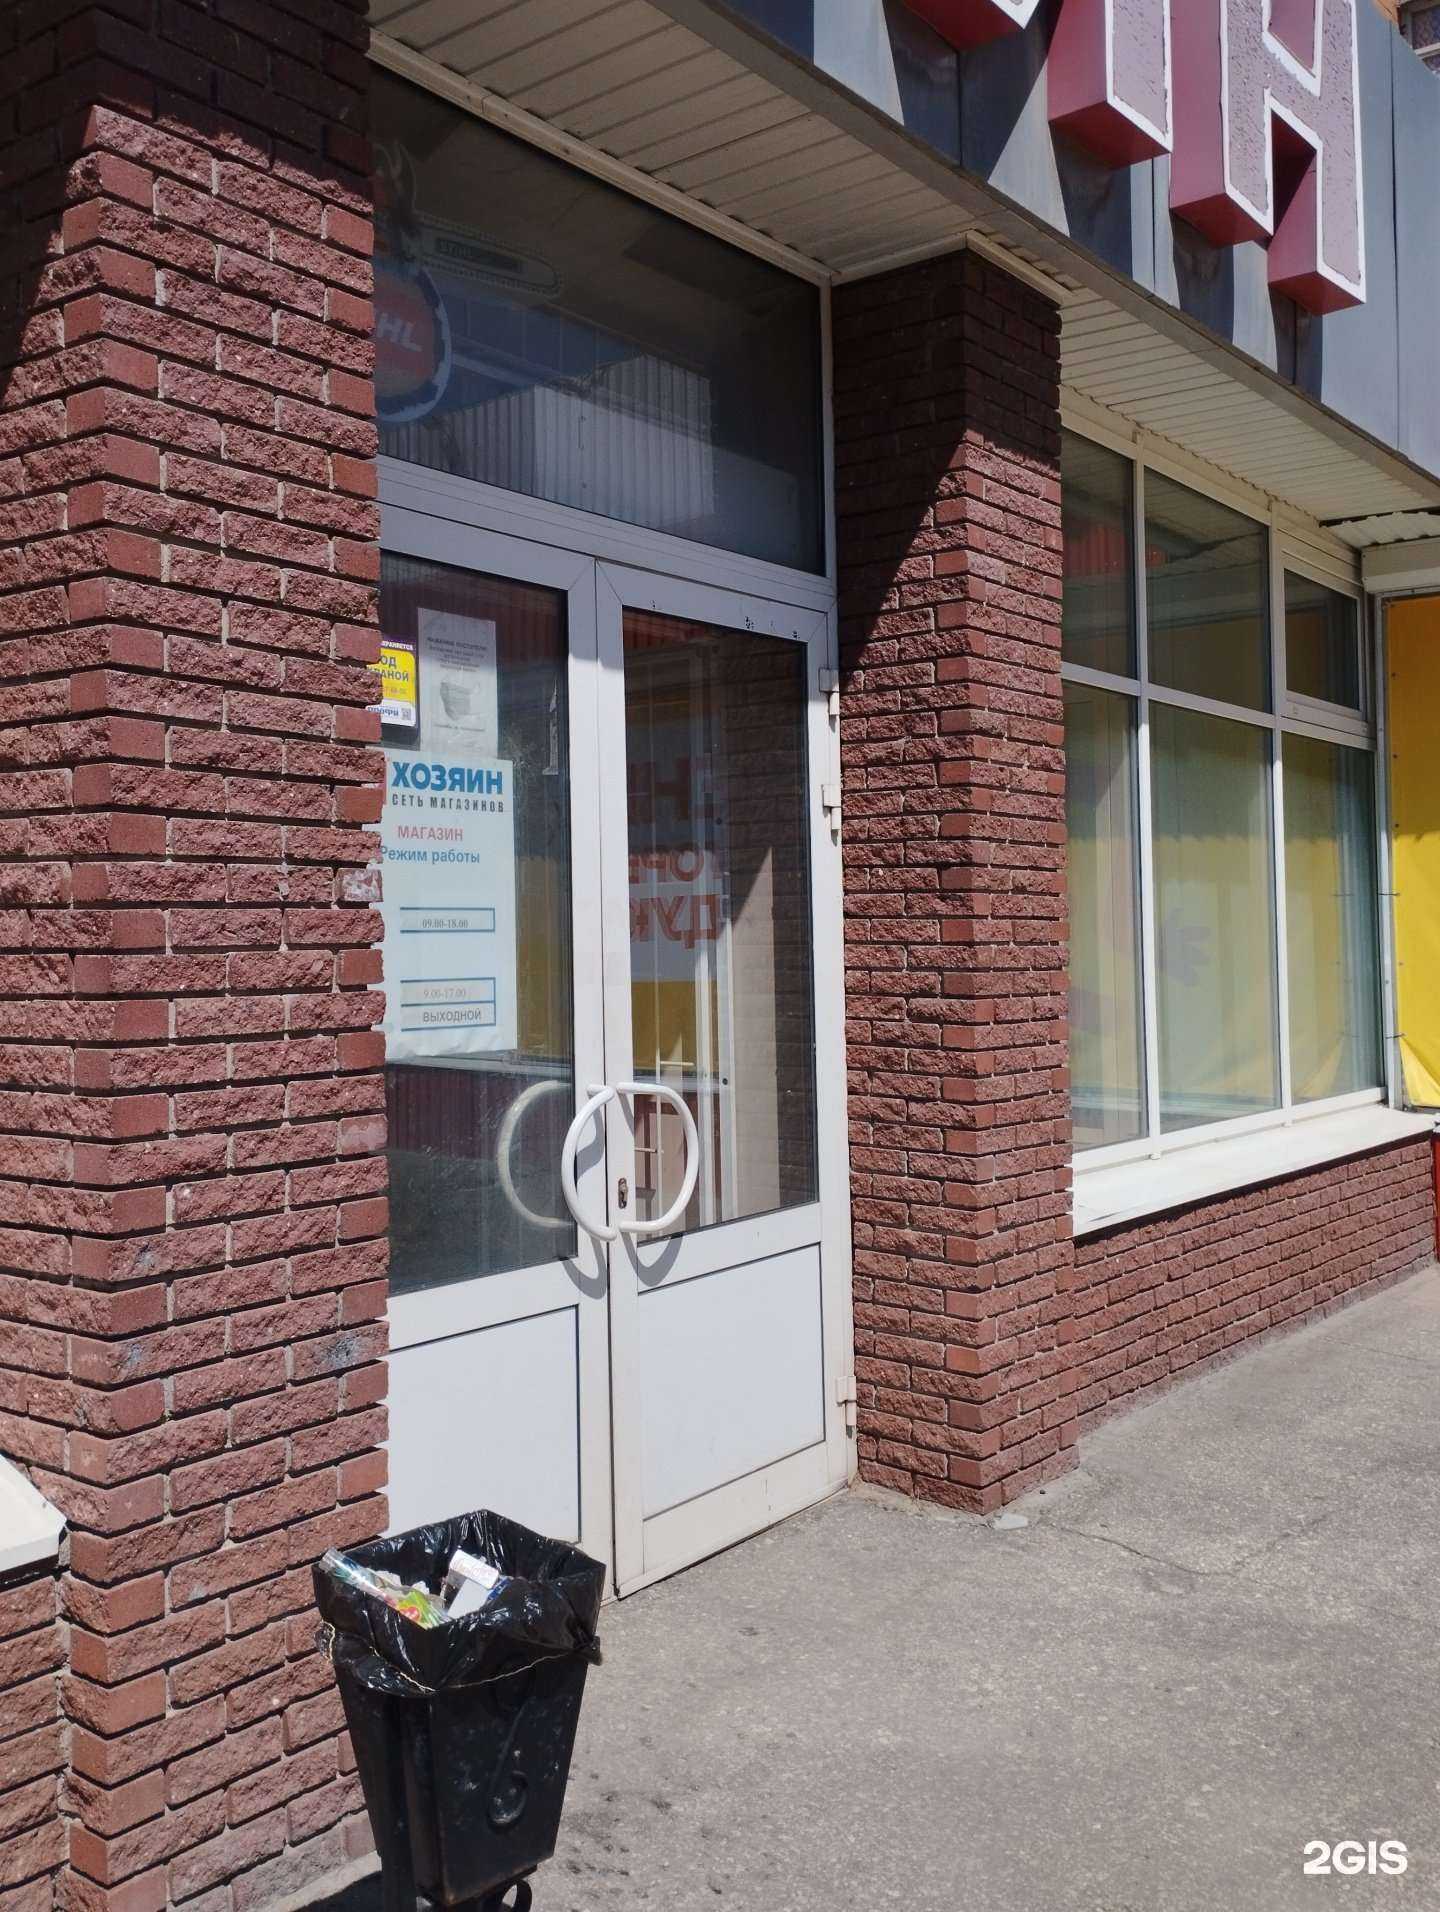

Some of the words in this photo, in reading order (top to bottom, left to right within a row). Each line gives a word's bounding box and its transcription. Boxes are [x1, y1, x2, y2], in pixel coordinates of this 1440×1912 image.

[380, 655, 397, 669] ОД
[391, 761, 504, 795] ХОЗЯИН
[392, 793, 424, 807] СЕТЬ
[430, 795, 504, 813] МАГАЗИНОВ
[397, 826, 463, 841] МАГАЗИН
[432, 849, 480, 864] работы
[422, 918, 469, 929] 09.00-18.00
[422, 1007, 481, 1024] ВЫХОДНОЙ
